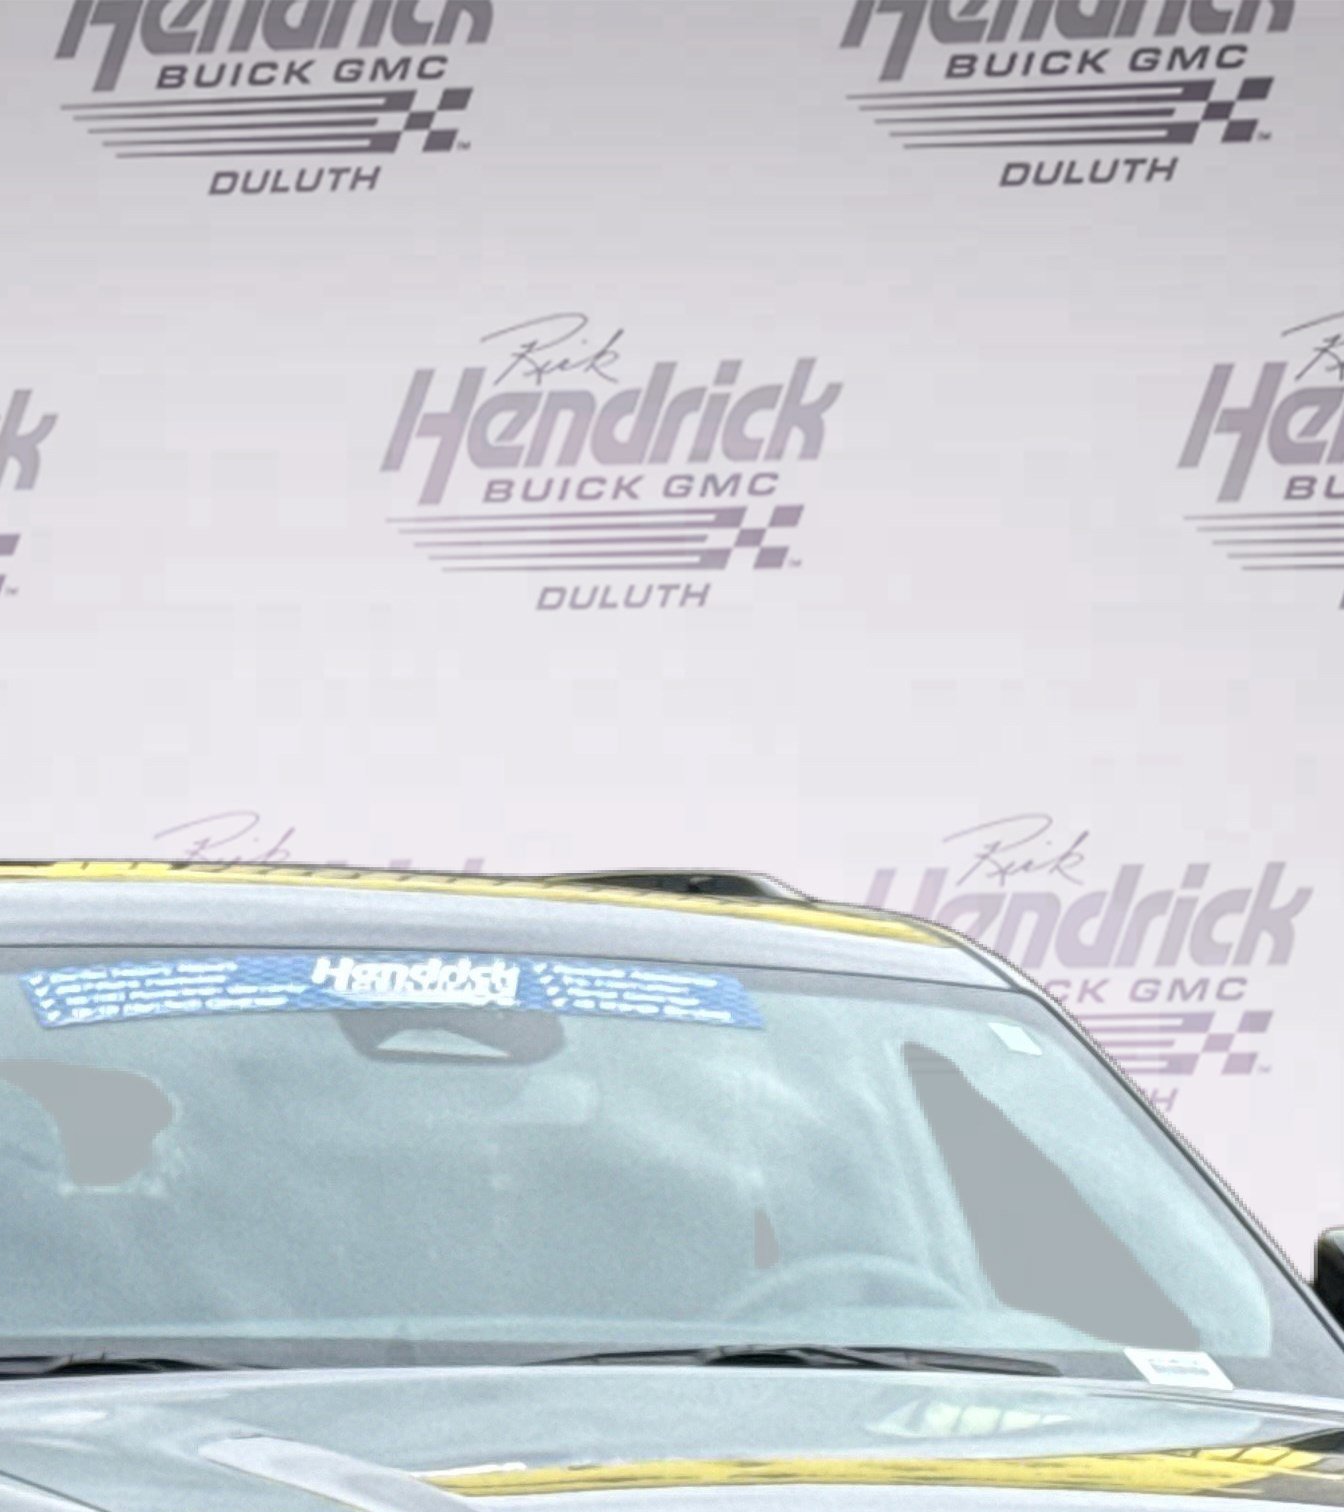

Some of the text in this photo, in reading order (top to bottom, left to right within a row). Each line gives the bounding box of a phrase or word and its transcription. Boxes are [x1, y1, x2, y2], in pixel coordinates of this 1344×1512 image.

[155, 54, 449, 90] BUICK GMC
[944, 43, 1249, 79] BUICK GMC
[207, 165, 382, 196] DULUTH
[998, 156, 1179, 188] DULUTH
[379, 357, 843, 506] Hendrick
[482, 472, 779, 503] BUICK GMC
[535, 583, 711, 611] DULUTH
[1129, 977, 1248, 1004] GMC
